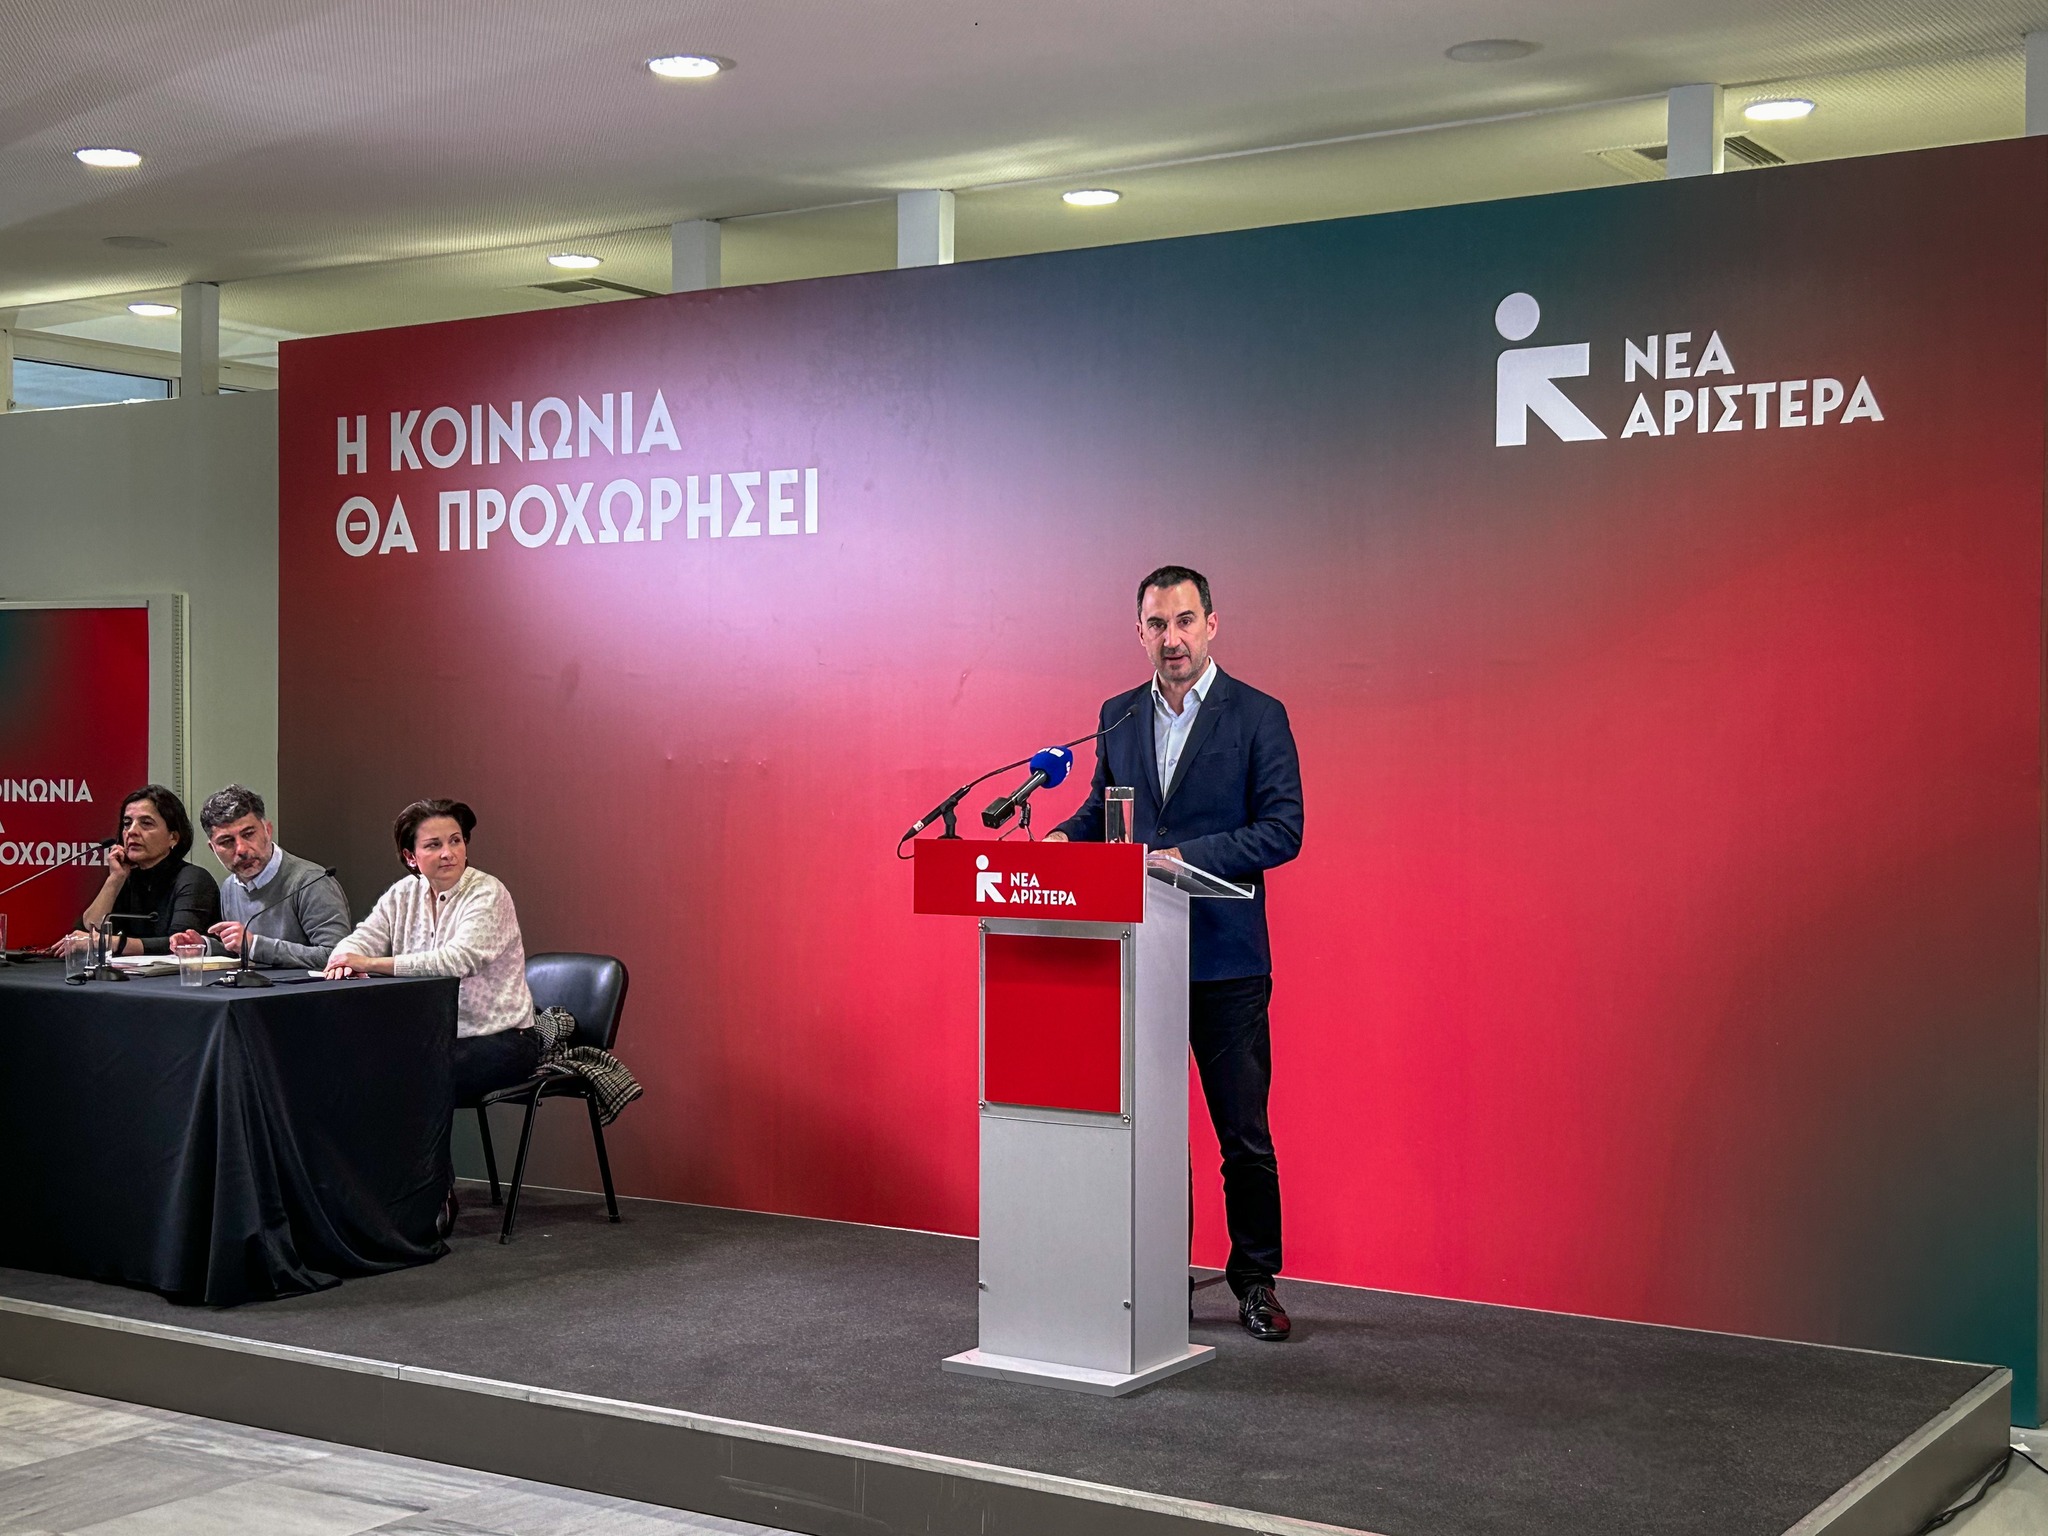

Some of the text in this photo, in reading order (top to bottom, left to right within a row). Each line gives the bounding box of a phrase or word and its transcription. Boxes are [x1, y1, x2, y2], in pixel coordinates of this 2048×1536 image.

[1624, 329, 1736, 383] ΝΕΑ
[336, 388, 682, 476] Η ΚΟΙΝΩΝΙΑ
[1619, 375, 1885, 439] ΑΡΙΣΤΕΡΑ
[335, 467, 819, 557] ΘΑ ΠΡΟΧΩΡΗΣΕΙ
[0, 778, 94, 803] ΙΝΩΝΙΑ
[1009, 889, 1077, 906] ΑΡΙΣΤΕΡΑ
[1010, 872, 1040, 888] ΝΕΑ
